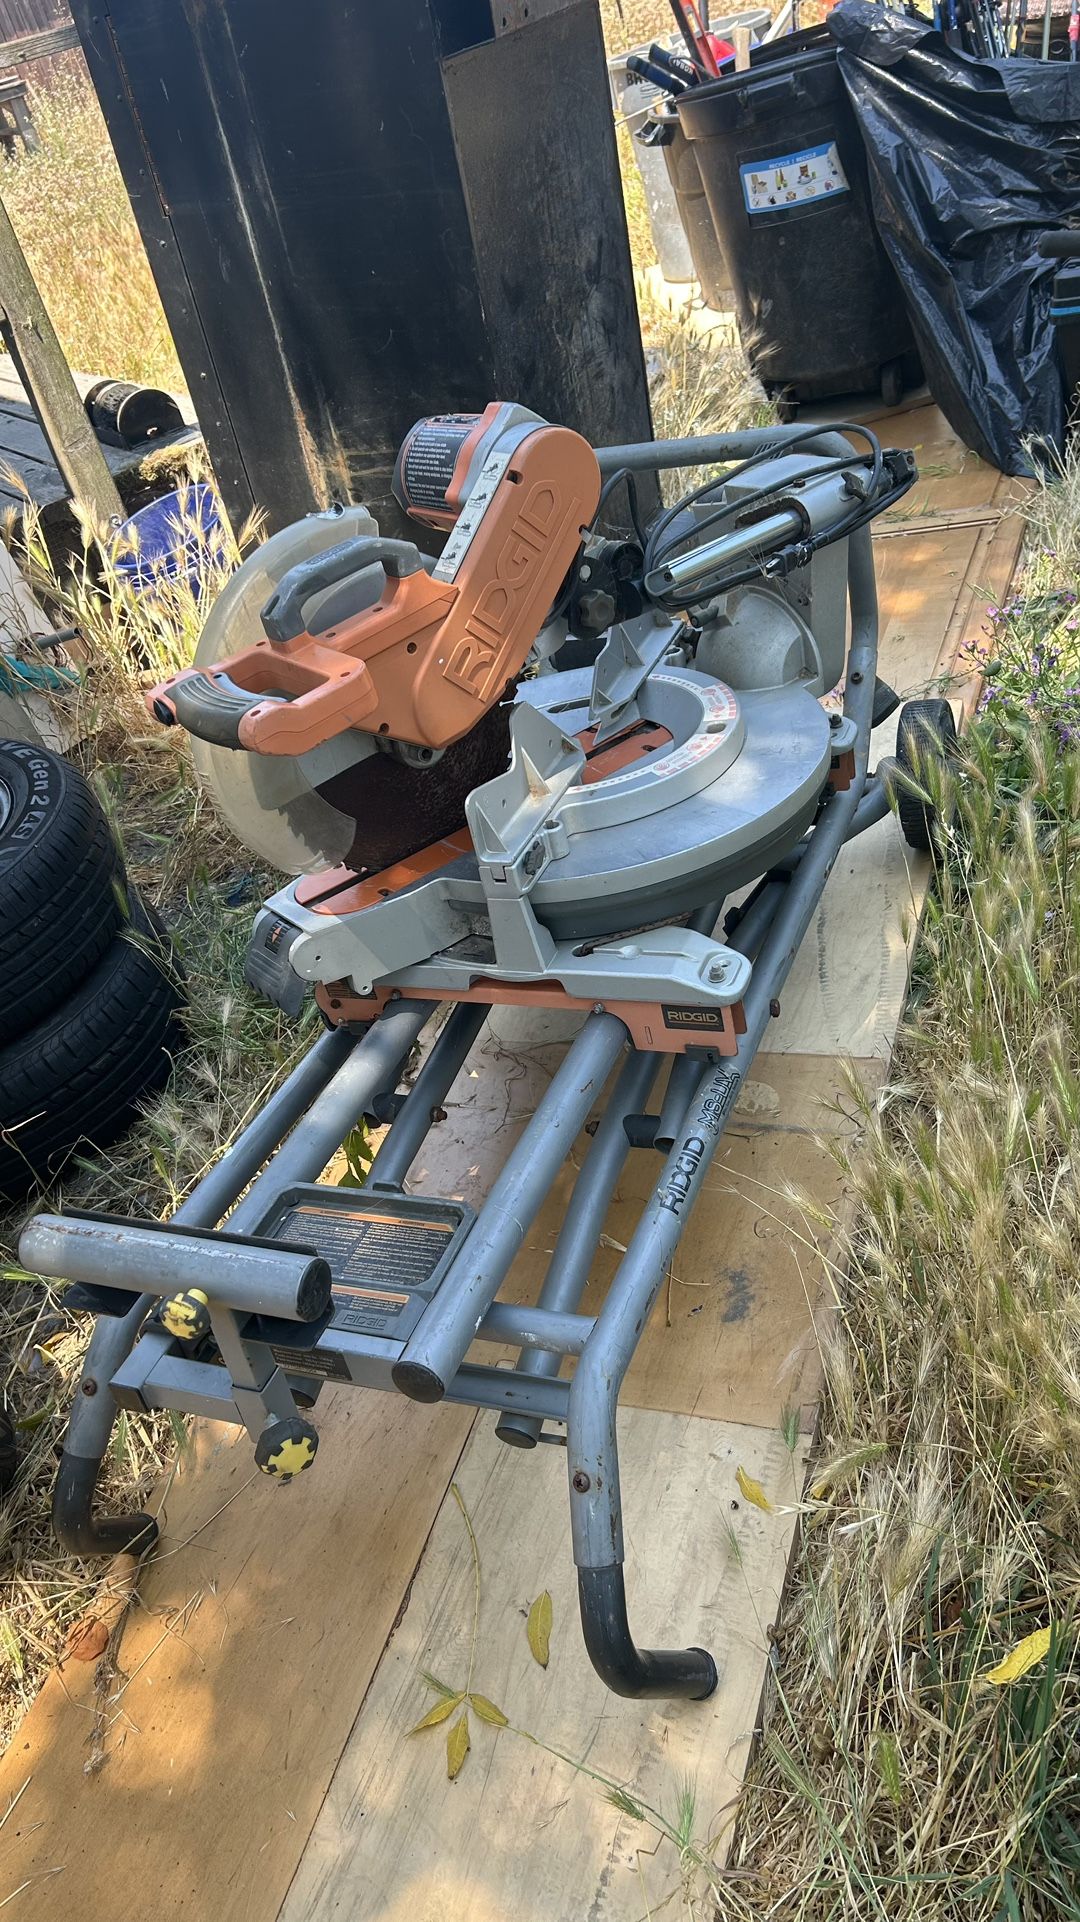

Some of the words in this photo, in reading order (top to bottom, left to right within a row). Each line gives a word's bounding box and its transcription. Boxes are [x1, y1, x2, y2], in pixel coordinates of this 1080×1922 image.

[442, 479, 563, 695] RIDGID
[27, 759, 50, 791] Gen
[30, 794, 50, 806] 2
[667, 1011, 719, 1023] RIDGID
[659, 1136, 705, 1216] RIDGID
[343, 1314, 388, 1328] RIDGID
